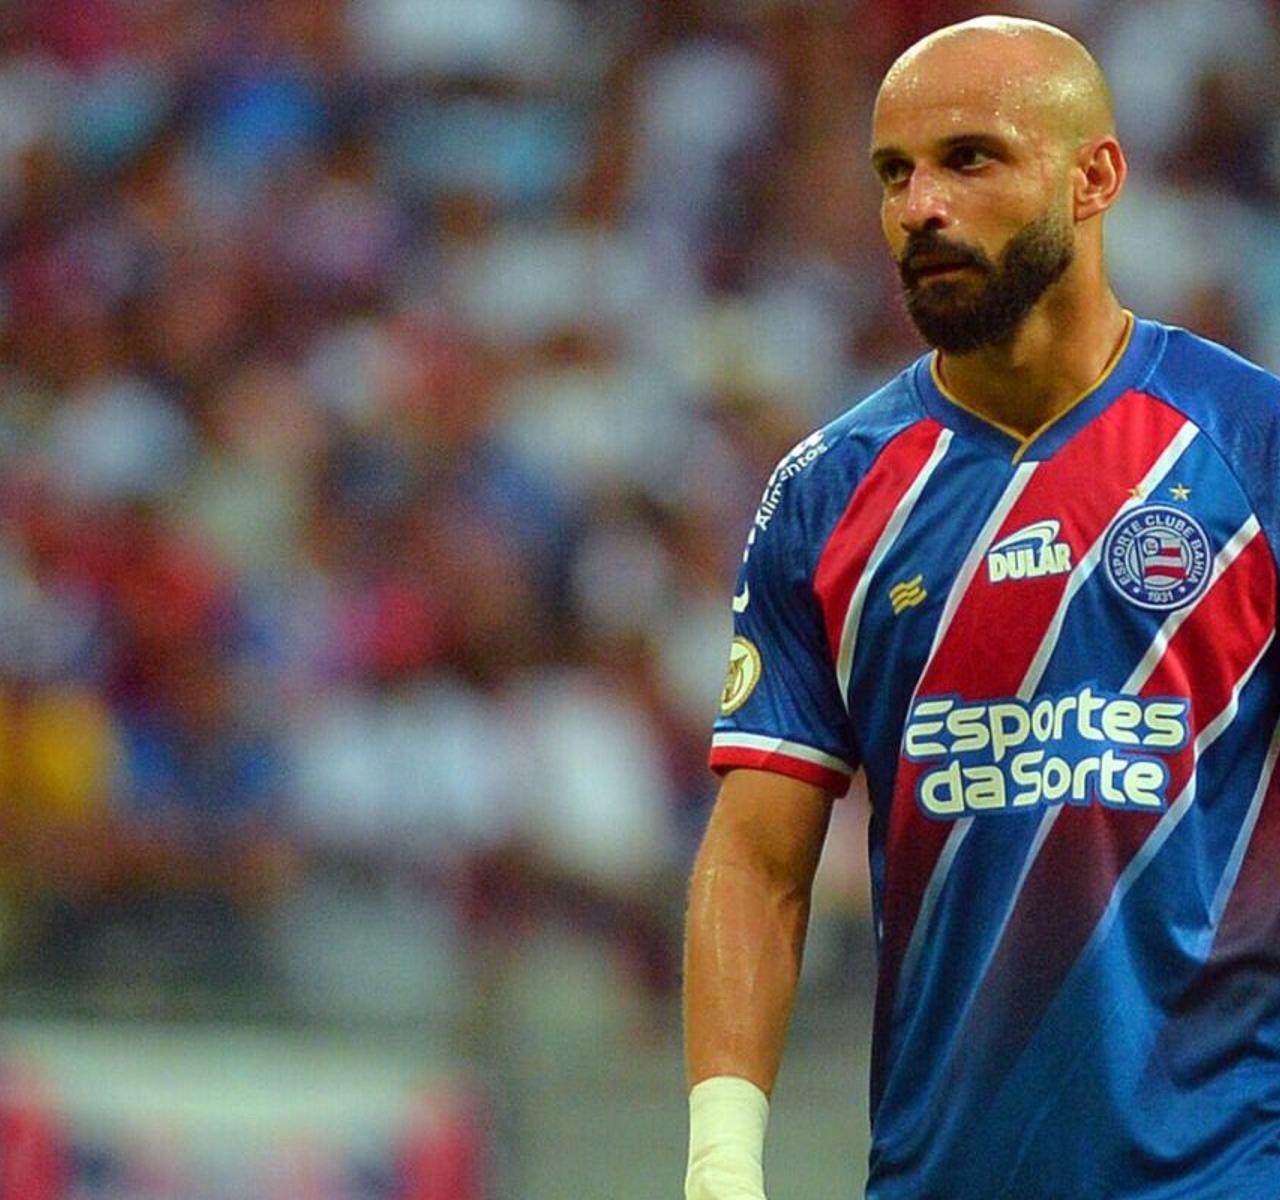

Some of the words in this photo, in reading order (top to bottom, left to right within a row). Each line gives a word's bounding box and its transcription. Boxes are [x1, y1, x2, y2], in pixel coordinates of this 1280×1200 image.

[988, 542, 1072, 583] DULAR
[1113, 521, 1142, 586] ESPORTE
[1145, 514, 1195, 539] CLUBE
[1189, 539, 1207, 584] BAHIA
[1147, 591, 1175, 604] 1931
[905, 687, 1185, 762] Esportes
[922, 760, 1006, 815] da
[1010, 750, 1165, 807] Sorte
